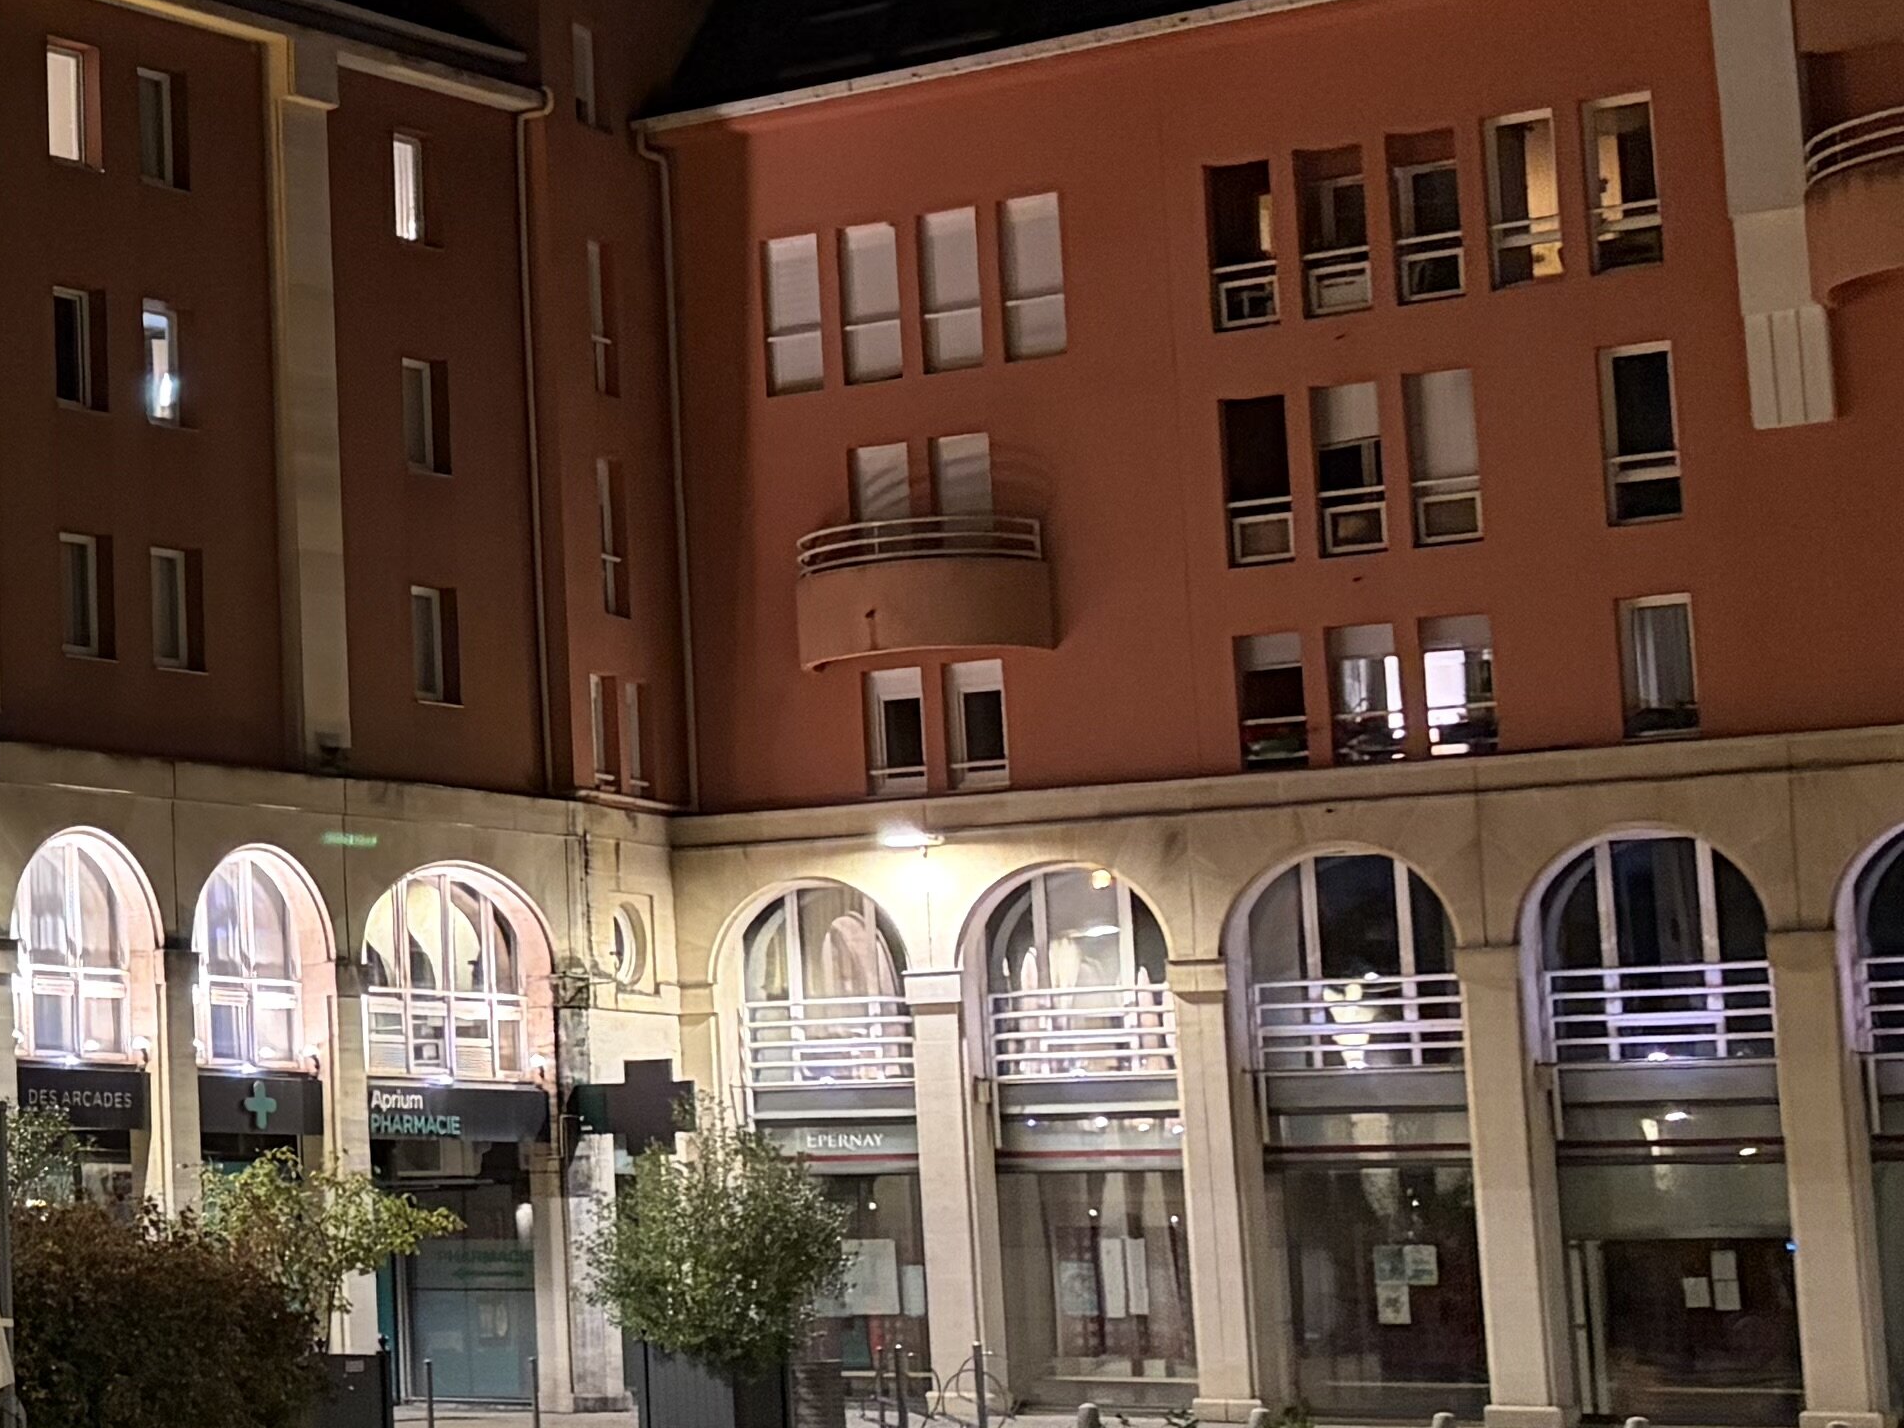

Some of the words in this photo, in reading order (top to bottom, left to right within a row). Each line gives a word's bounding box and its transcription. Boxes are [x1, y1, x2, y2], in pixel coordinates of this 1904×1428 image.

[28, 1089, 57, 1105] DES
[62, 1090, 132, 1108] ARCADES
[371, 1089, 423, 1112] Aprium
[371, 1113, 461, 1135] PHARMACIE
[806, 1133, 883, 1150] EPERNAY
